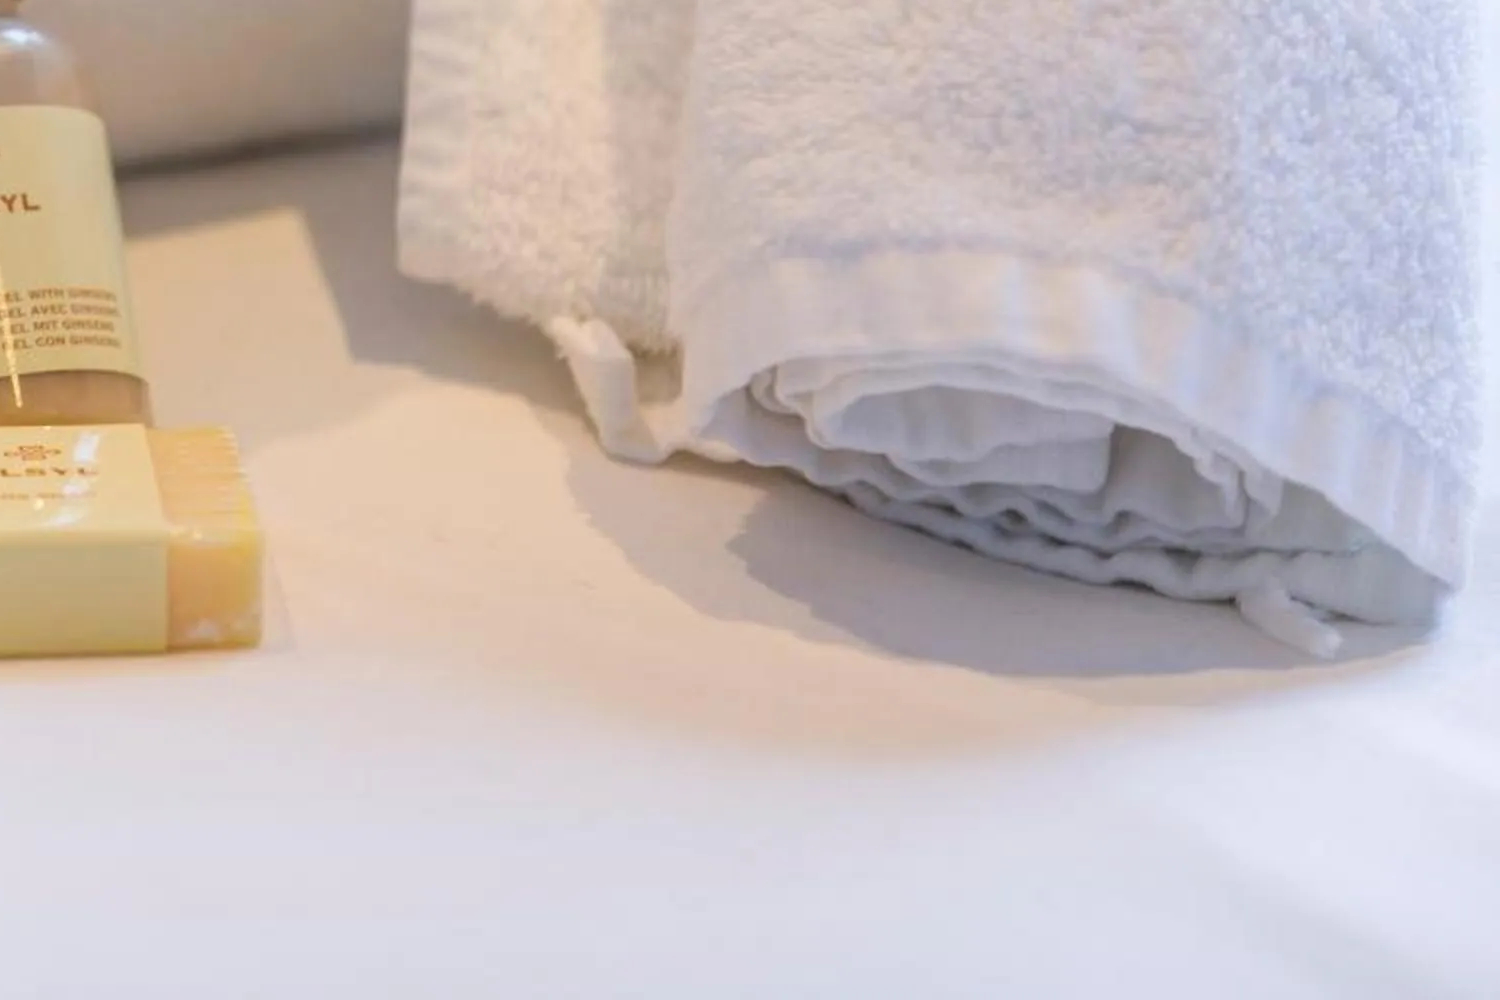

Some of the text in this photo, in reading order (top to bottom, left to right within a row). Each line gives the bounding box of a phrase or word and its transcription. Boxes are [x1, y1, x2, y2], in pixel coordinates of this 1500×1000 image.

[27, 288, 64, 300] WITH
[31, 304, 68, 315] AVEC
[32, 320, 59, 331] MIT
[35, 336, 66, 347] CON
